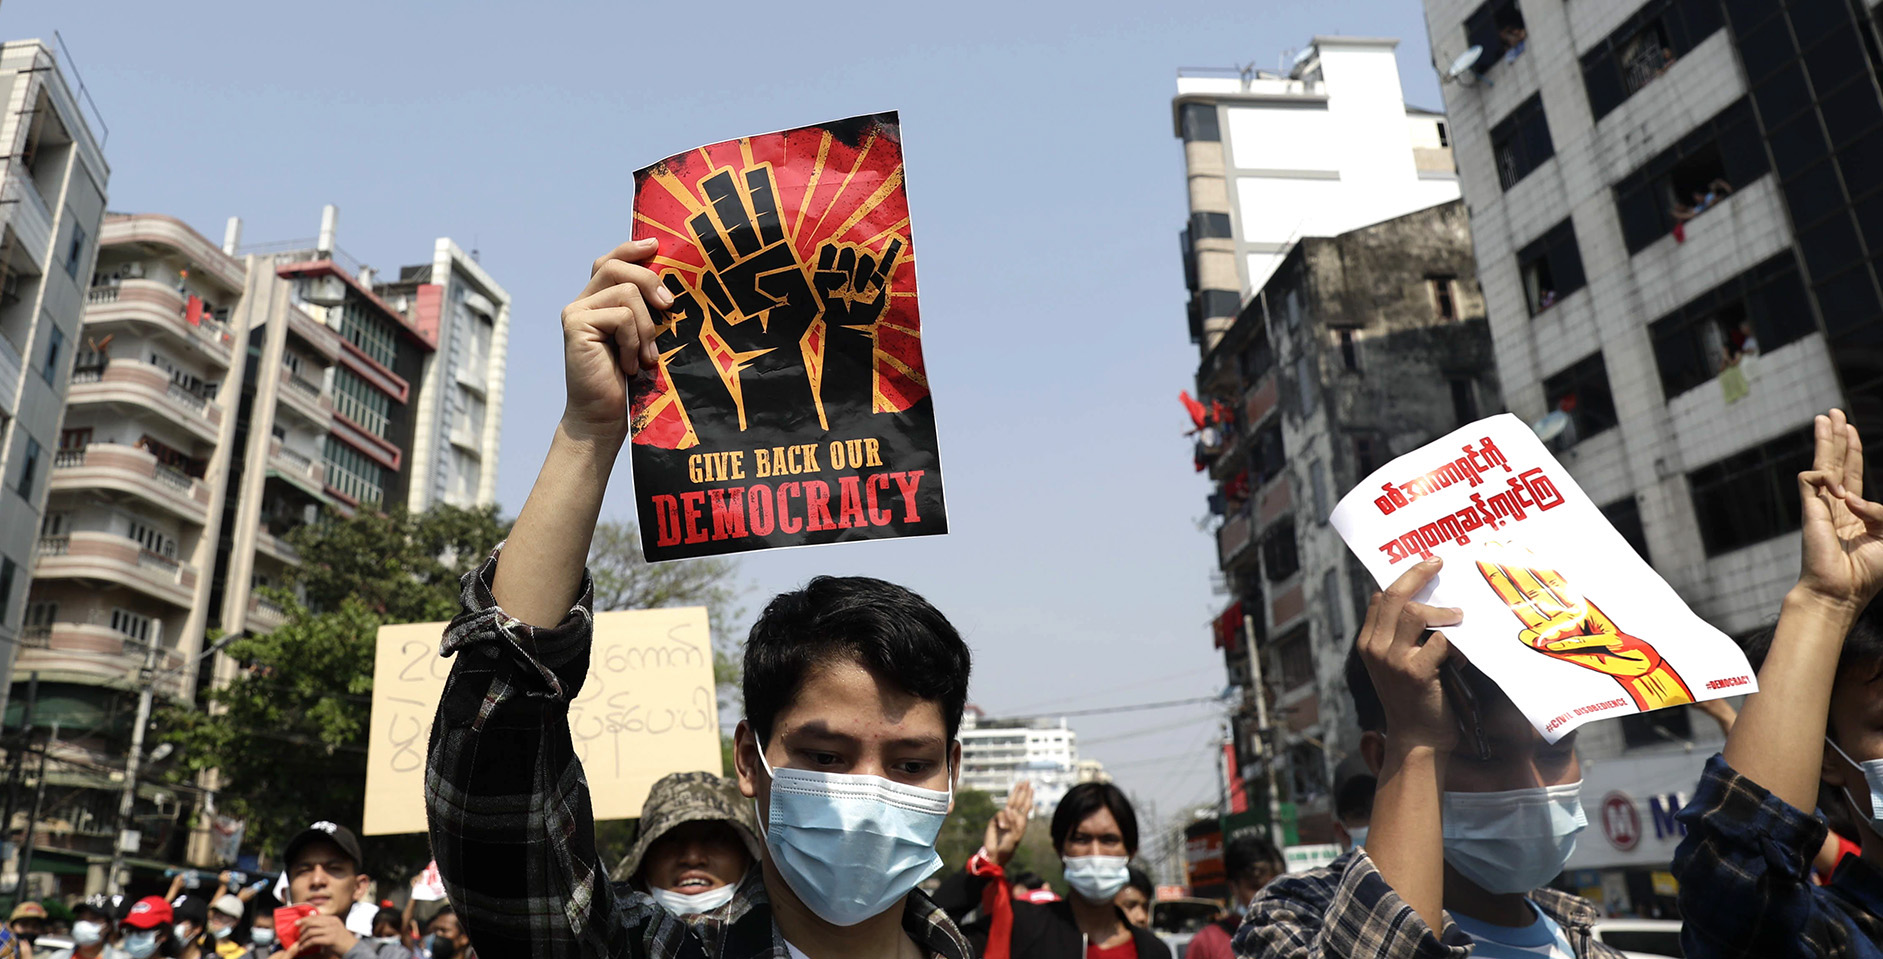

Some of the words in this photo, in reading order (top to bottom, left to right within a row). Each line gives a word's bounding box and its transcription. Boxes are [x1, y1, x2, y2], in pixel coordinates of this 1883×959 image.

[688, 450, 746, 484] GIVE
[755, 443, 821, 479] BACK
[830, 437, 883, 470] OUR
[652, 470, 925, 548] DEMOCRACY
[1706, 675, 1752, 690] #DEMOCRACY
[1545, 711, 1574, 734] #CIVIL
[1572, 697, 1629, 717] DISOBEDIENCE
